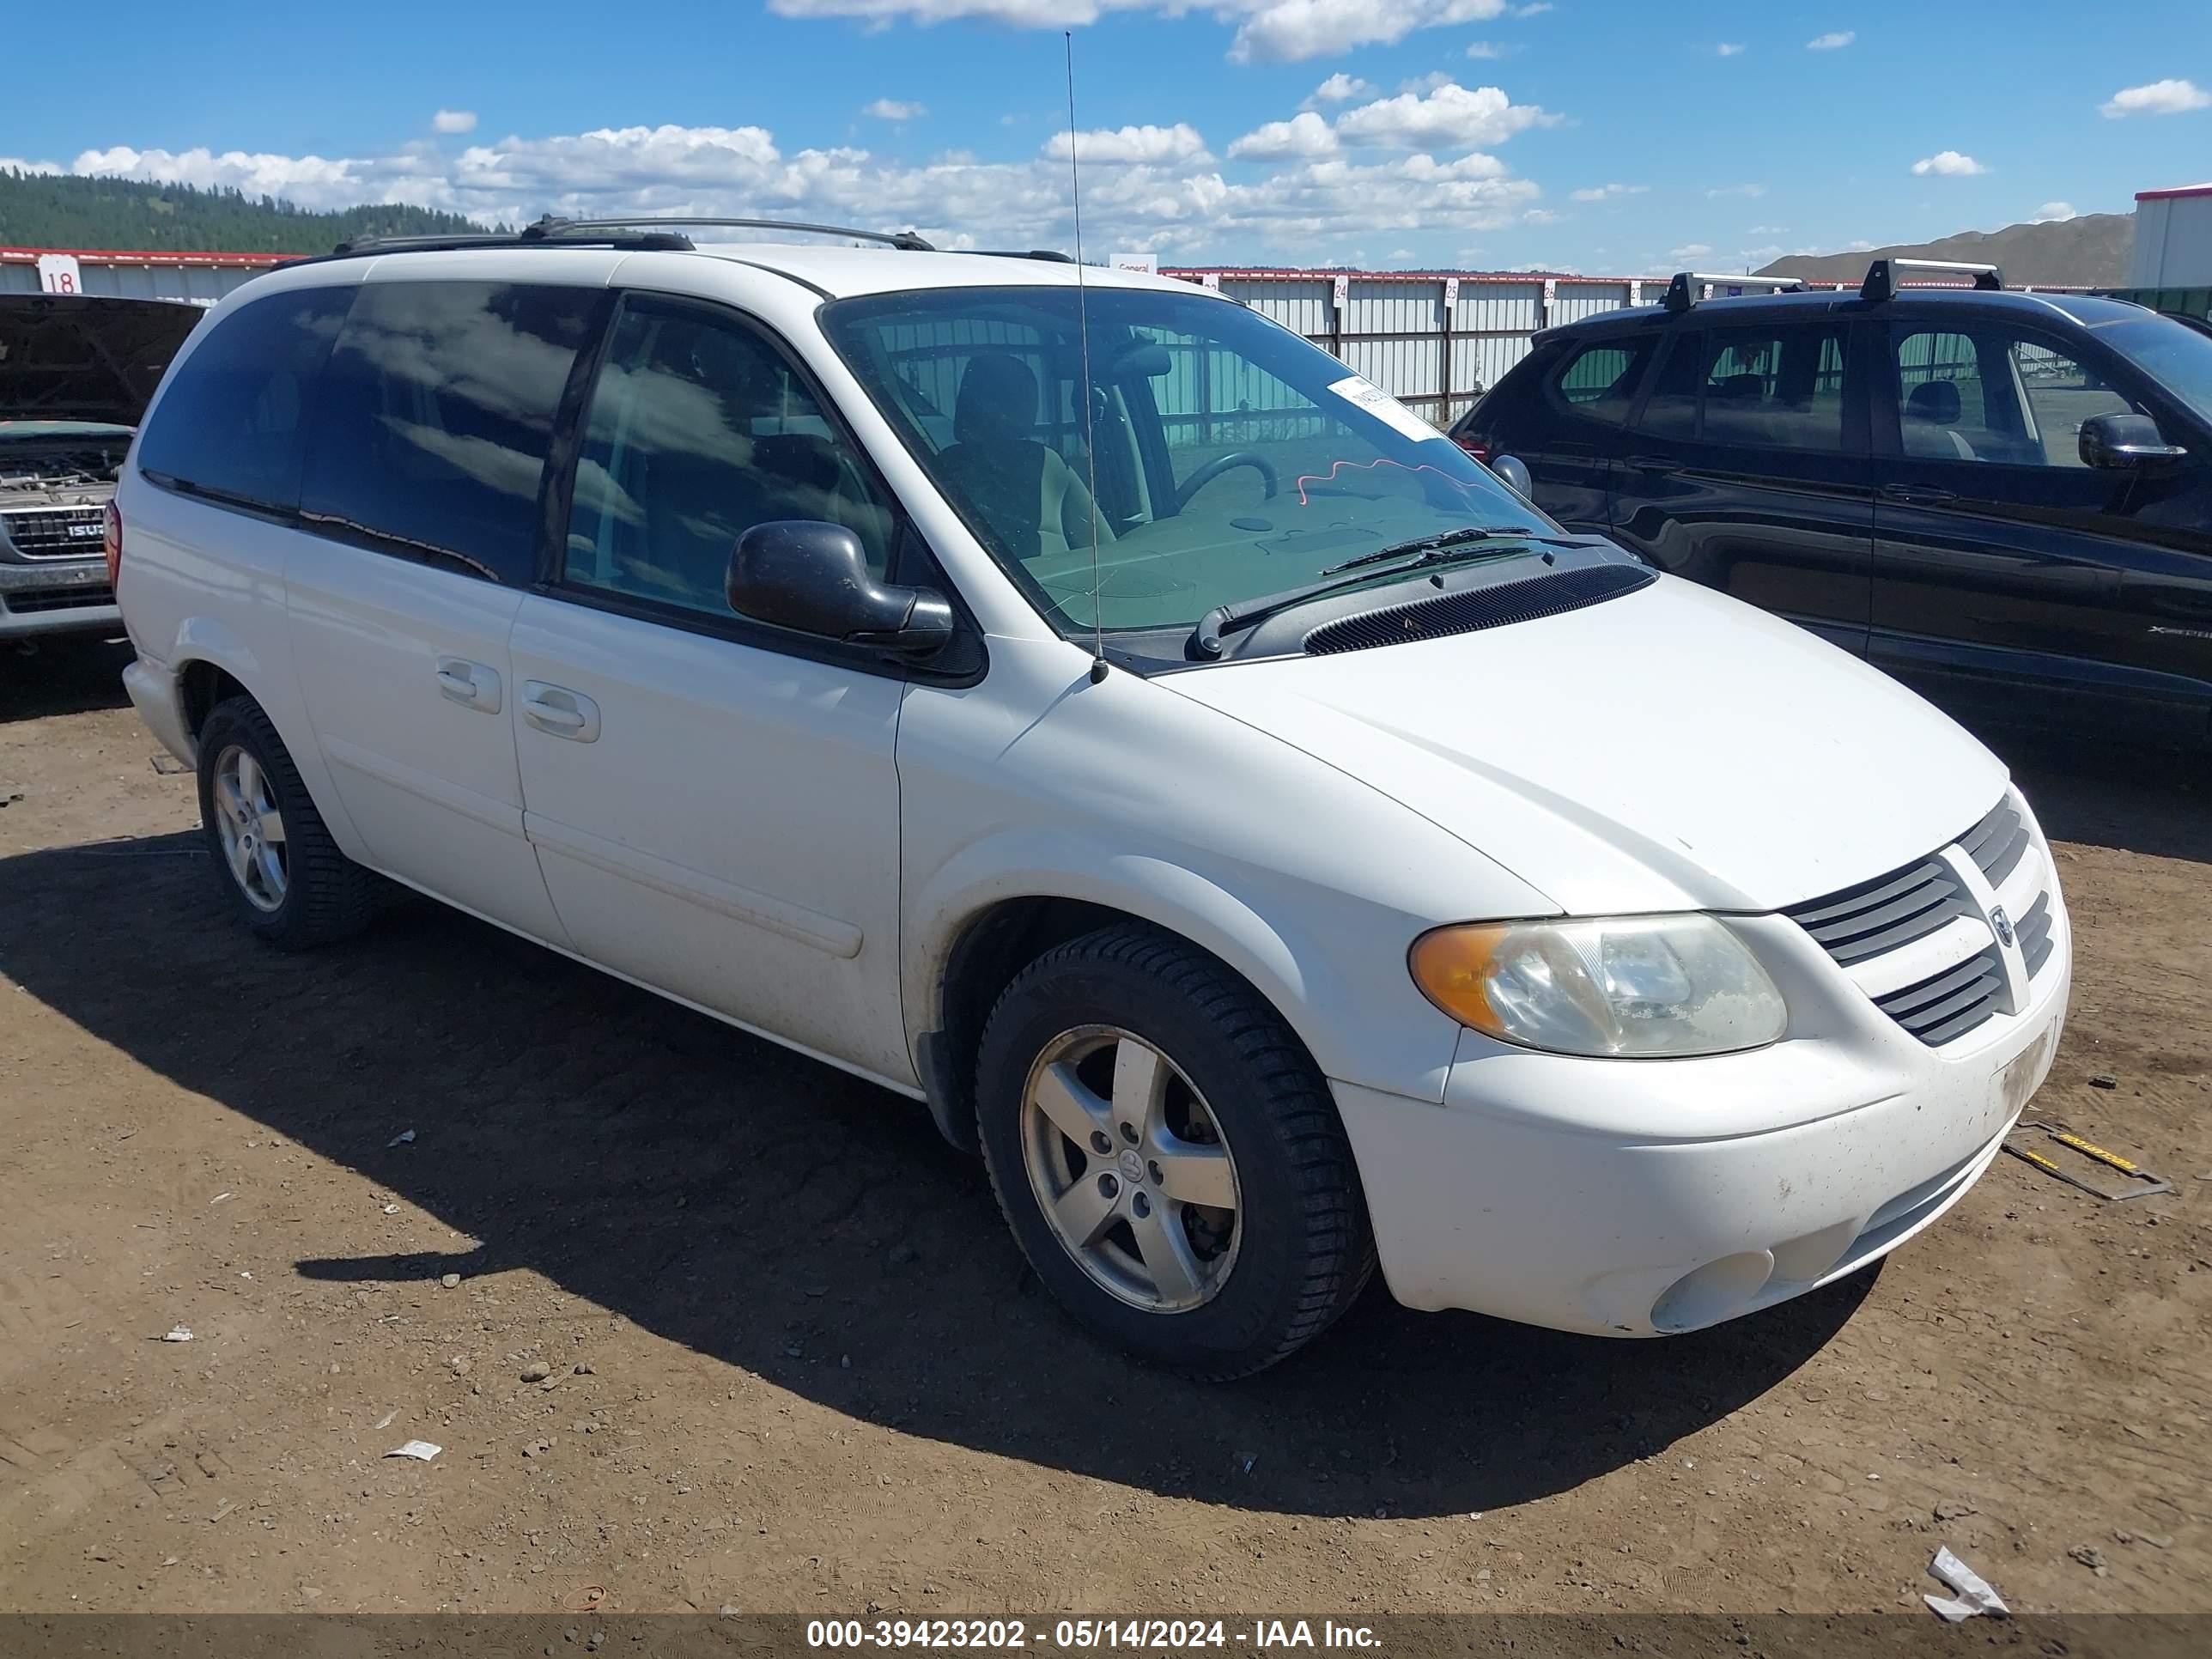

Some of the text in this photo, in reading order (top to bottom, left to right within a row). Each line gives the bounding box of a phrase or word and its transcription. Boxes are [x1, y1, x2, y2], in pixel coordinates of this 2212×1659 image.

[48, 272, 75, 294] 18
[1334, 284, 1346, 299] 24
[1446, 285, 1457, 300] 25
[1545, 287, 1554, 299] 26
[1631, 288, 1641, 299] 27
